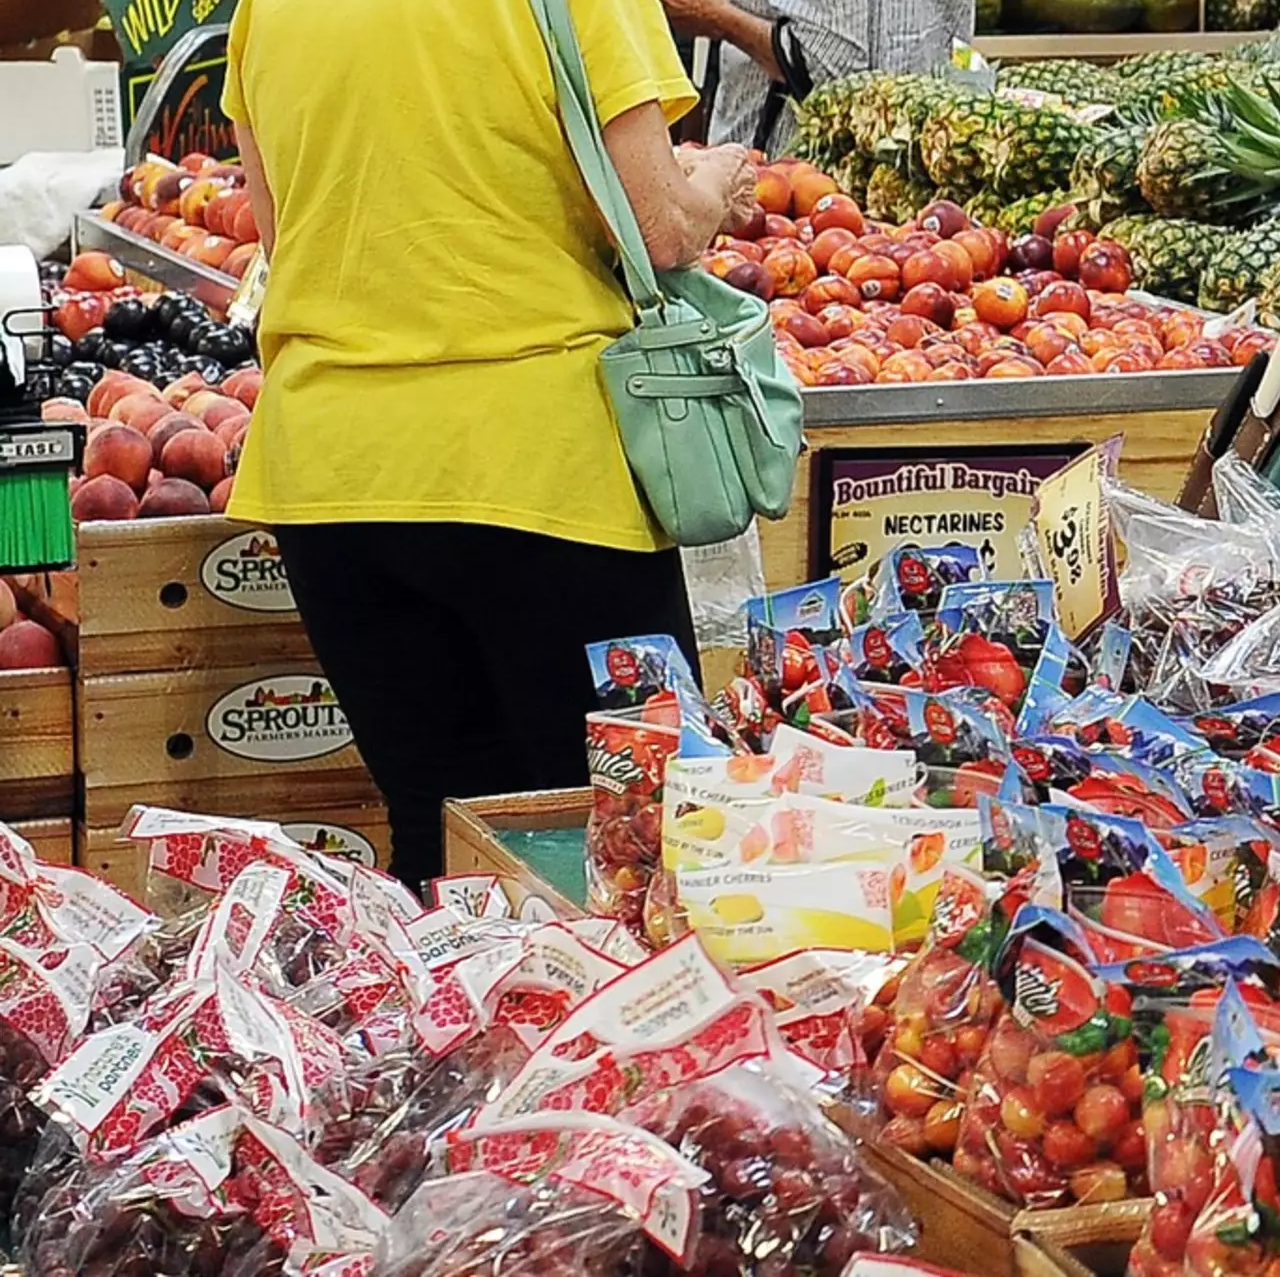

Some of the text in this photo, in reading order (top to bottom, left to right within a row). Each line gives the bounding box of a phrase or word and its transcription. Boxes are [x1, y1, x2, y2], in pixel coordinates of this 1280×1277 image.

[834, 464, 947, 506] Bountiful
[882, 512, 1006, 537] NECTARINES
[246, 731, 301, 744] FARMERS
[722, 872, 773, 887] CHERRIES
[418, 932, 481, 964] partn
[98, 1041, 141, 1096] partner
